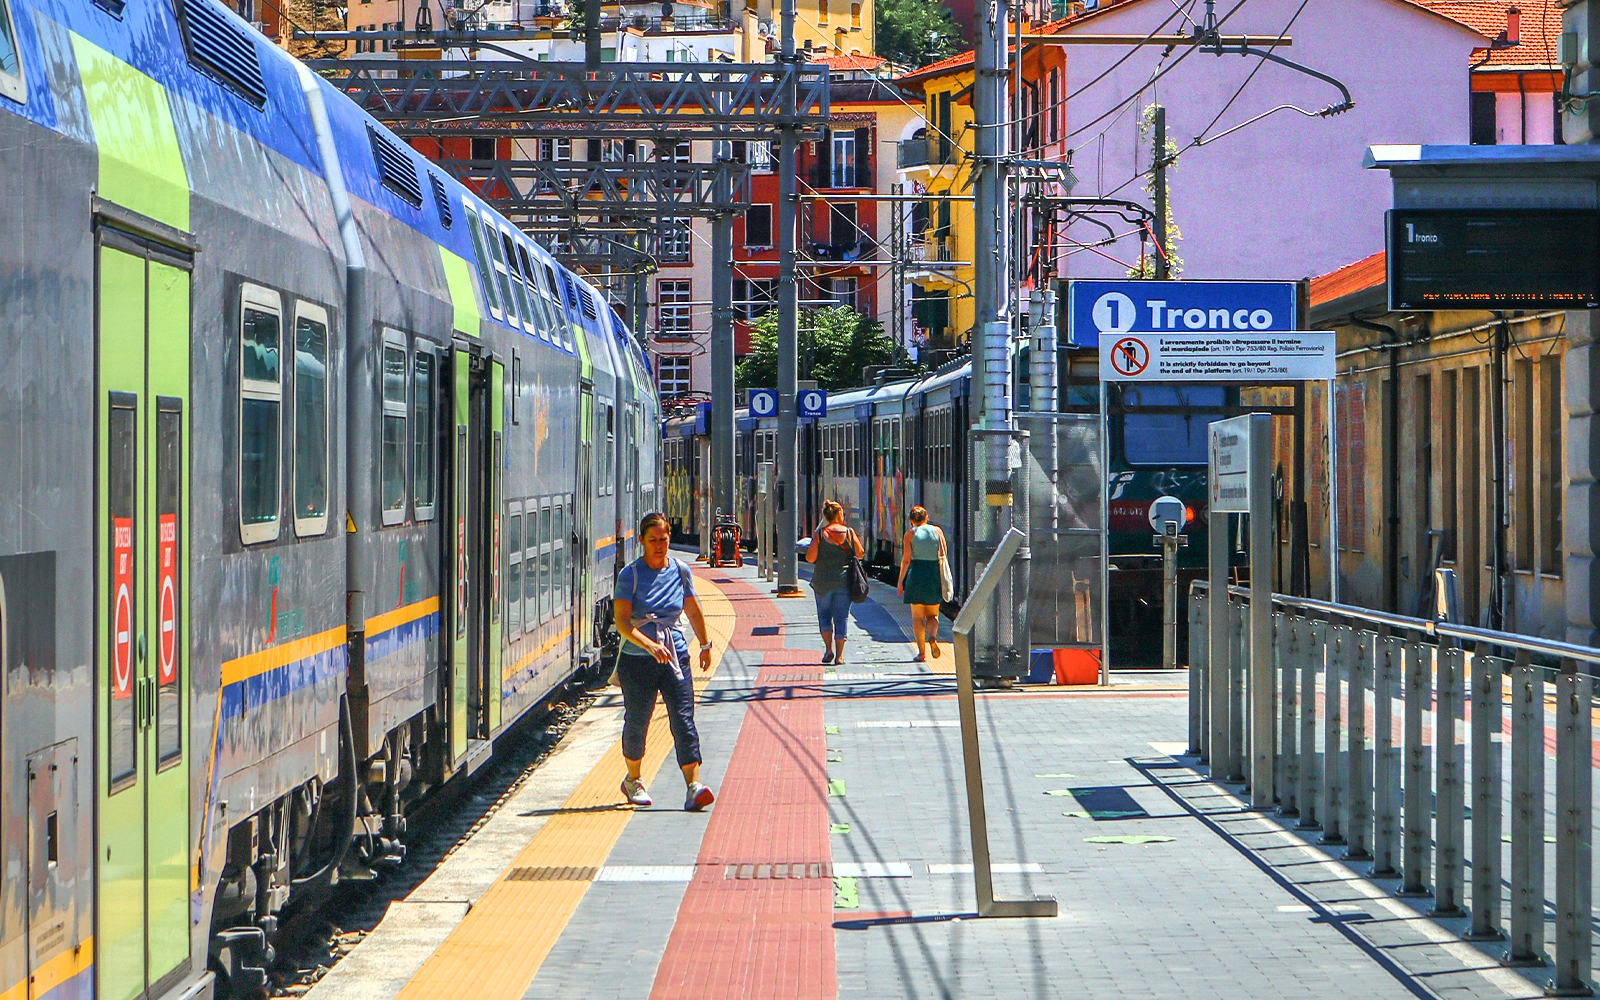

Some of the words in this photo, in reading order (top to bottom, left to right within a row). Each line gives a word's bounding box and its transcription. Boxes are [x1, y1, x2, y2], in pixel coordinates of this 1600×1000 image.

[1405, 223, 1414, 243] 1
[1106, 299, 1119, 329] 1
[1146, 299, 1273, 330] Tronco
[1232, 338, 1271, 346] oltrepassare
[759, 396, 767, 410] 1
[809, 396, 816, 408] 1
